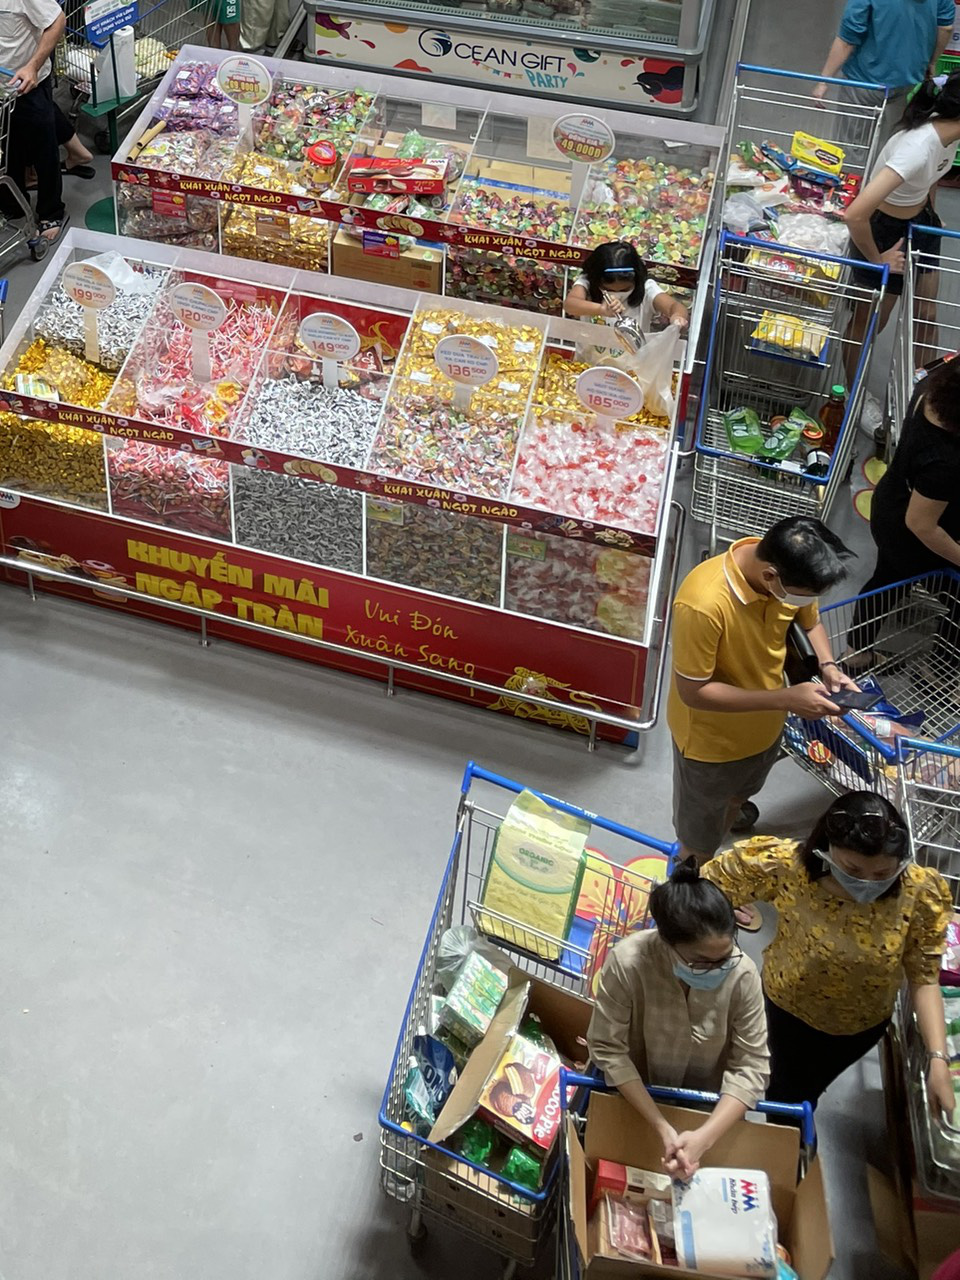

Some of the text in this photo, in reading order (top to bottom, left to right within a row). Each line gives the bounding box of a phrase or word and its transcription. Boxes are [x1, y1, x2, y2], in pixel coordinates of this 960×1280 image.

[226, 4, 236, 18] SEA
[521, 52, 566, 73] GIFT
[524, 68, 569, 89] PARTY
[180, 182, 231, 193] KHAI XUÂN
[224, 192, 282, 205] NGỌT NGÀO
[464, 234, 523, 247] KHAI XUÂN
[515, 246, 581, 260] NGỌT NGÀO
[59, 411, 116, 426] KHAI XUÂN
[109, 426, 174, 441] NGỌT NGÀO
[384, 484, 451, 501] KHAI XUÂN
[442, 500, 518, 518] NGỌT NGÀO
[127, 538, 329, 609] KHUYẾN MÃI
[232, 594, 323, 640] TRÀN
[364, 599, 459, 641] Vui Đón
[344, 624, 476, 697] Xuân Sang
[519, 847, 554, 867] ORGANIC
